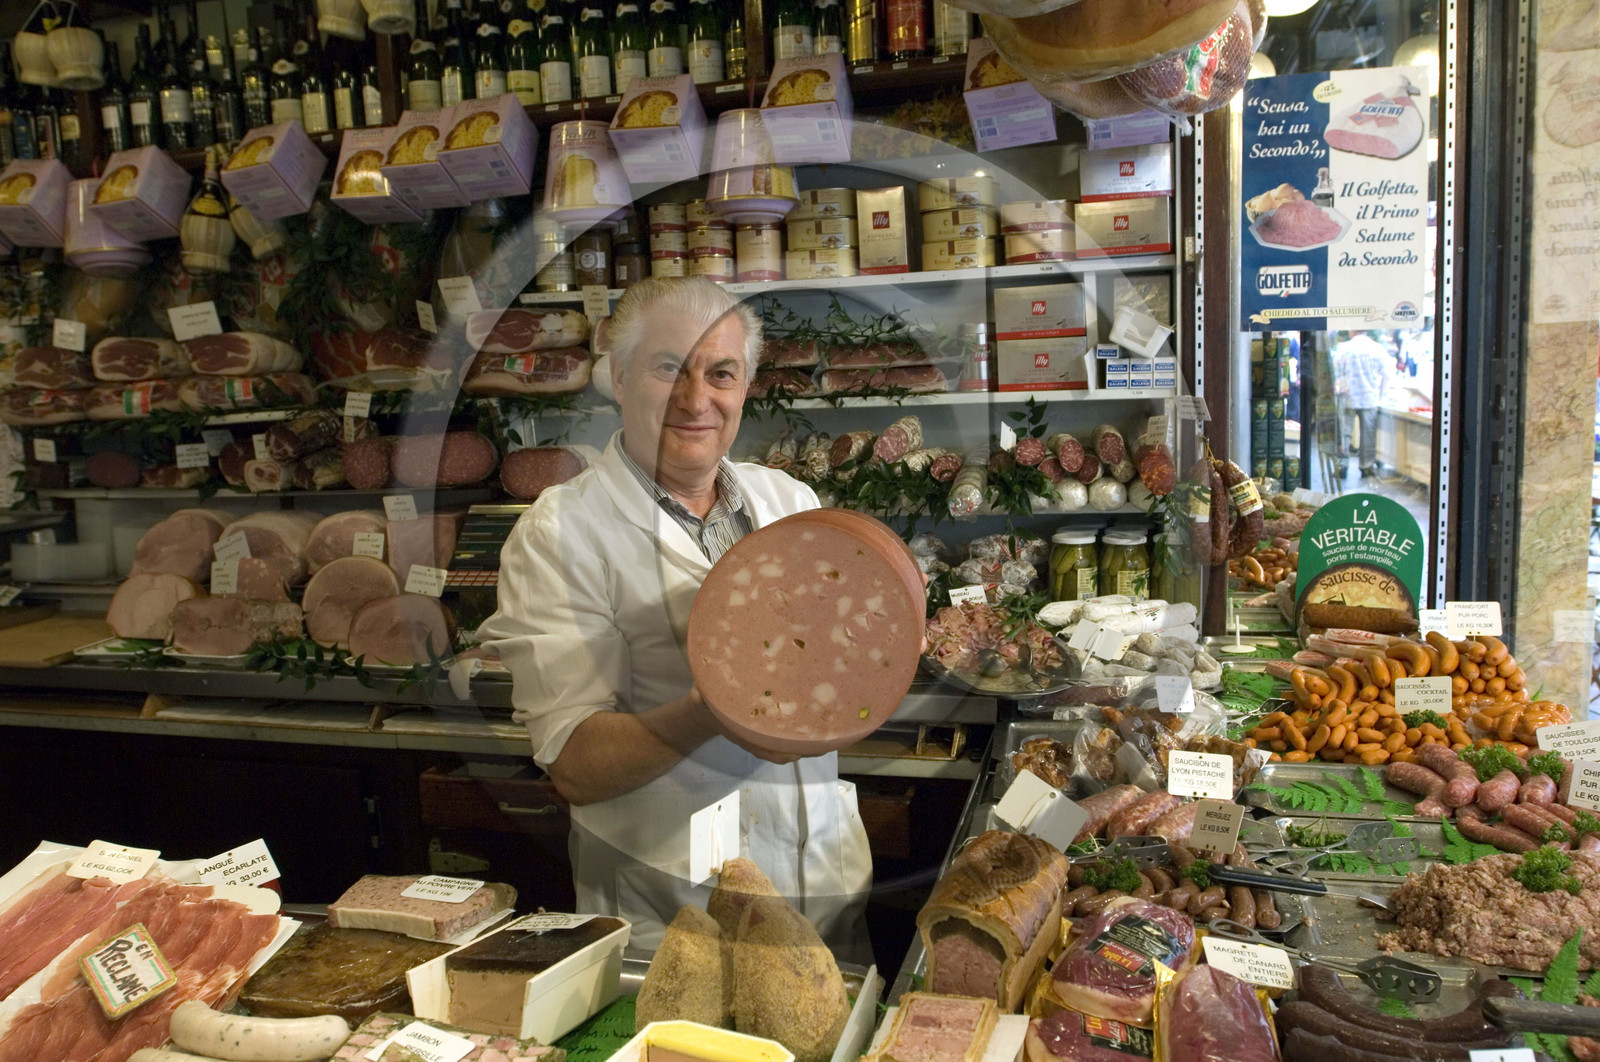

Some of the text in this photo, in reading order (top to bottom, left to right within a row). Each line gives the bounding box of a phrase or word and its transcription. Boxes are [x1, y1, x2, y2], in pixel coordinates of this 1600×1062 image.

[1258, 120, 1310, 136] hai un
[1120, 162, 1134, 175] illy
[1340, 180, 1419, 200] Il Golfetta,
[1356, 204, 1419, 220] il Primo
[874, 214, 888, 227] illy
[1114, 218, 1128, 230] illy
[1356, 228, 1414, 243] Salume
[1338, 250, 1418, 267] da Secondo
[1257, 272, 1312, 289] GOLFETTA
[1032, 303, 1046, 314] illy
[1264, 310, 1300, 318] CHIEDILO
[1329, 307, 1372, 316] SALUMIERE
[1036, 356, 1048, 367] illy
[1353, 509, 1378, 525] LA
[1310, 527, 1416, 556] VÉRITABLE
[1322, 544, 1355, 558] saucisse
[1369, 546, 1402, 561] morteau
[1326, 552, 1348, 566] porte
[1378, 577, 1395, 596] de
[1545, 730, 1586, 740] SAUCISSES
[1174, 758, 1210, 768] SAUCISON
[1192, 770, 1226, 778] PISTACHE
[1580, 780, 1598, 788] PUR
[1206, 811, 1232, 821] MERGUEZ
[198, 858, 234, 876] LANGUE
[222, 854, 268, 876] ECARLATE
[240, 870, 262, 882] 33.00
[433, 878, 478, 886] CAMPAGNE
[426, 881, 456, 889] POIVRE
[1213, 946, 1258, 958] MAGRETS
[1248, 959, 1287, 970] CANARD
[96, 939, 149, 1004] RECLAME
[1248, 966, 1288, 978] ENTIERS
[1254, 974, 1268, 982] KG
[406, 1032, 444, 1047] JAMBON
